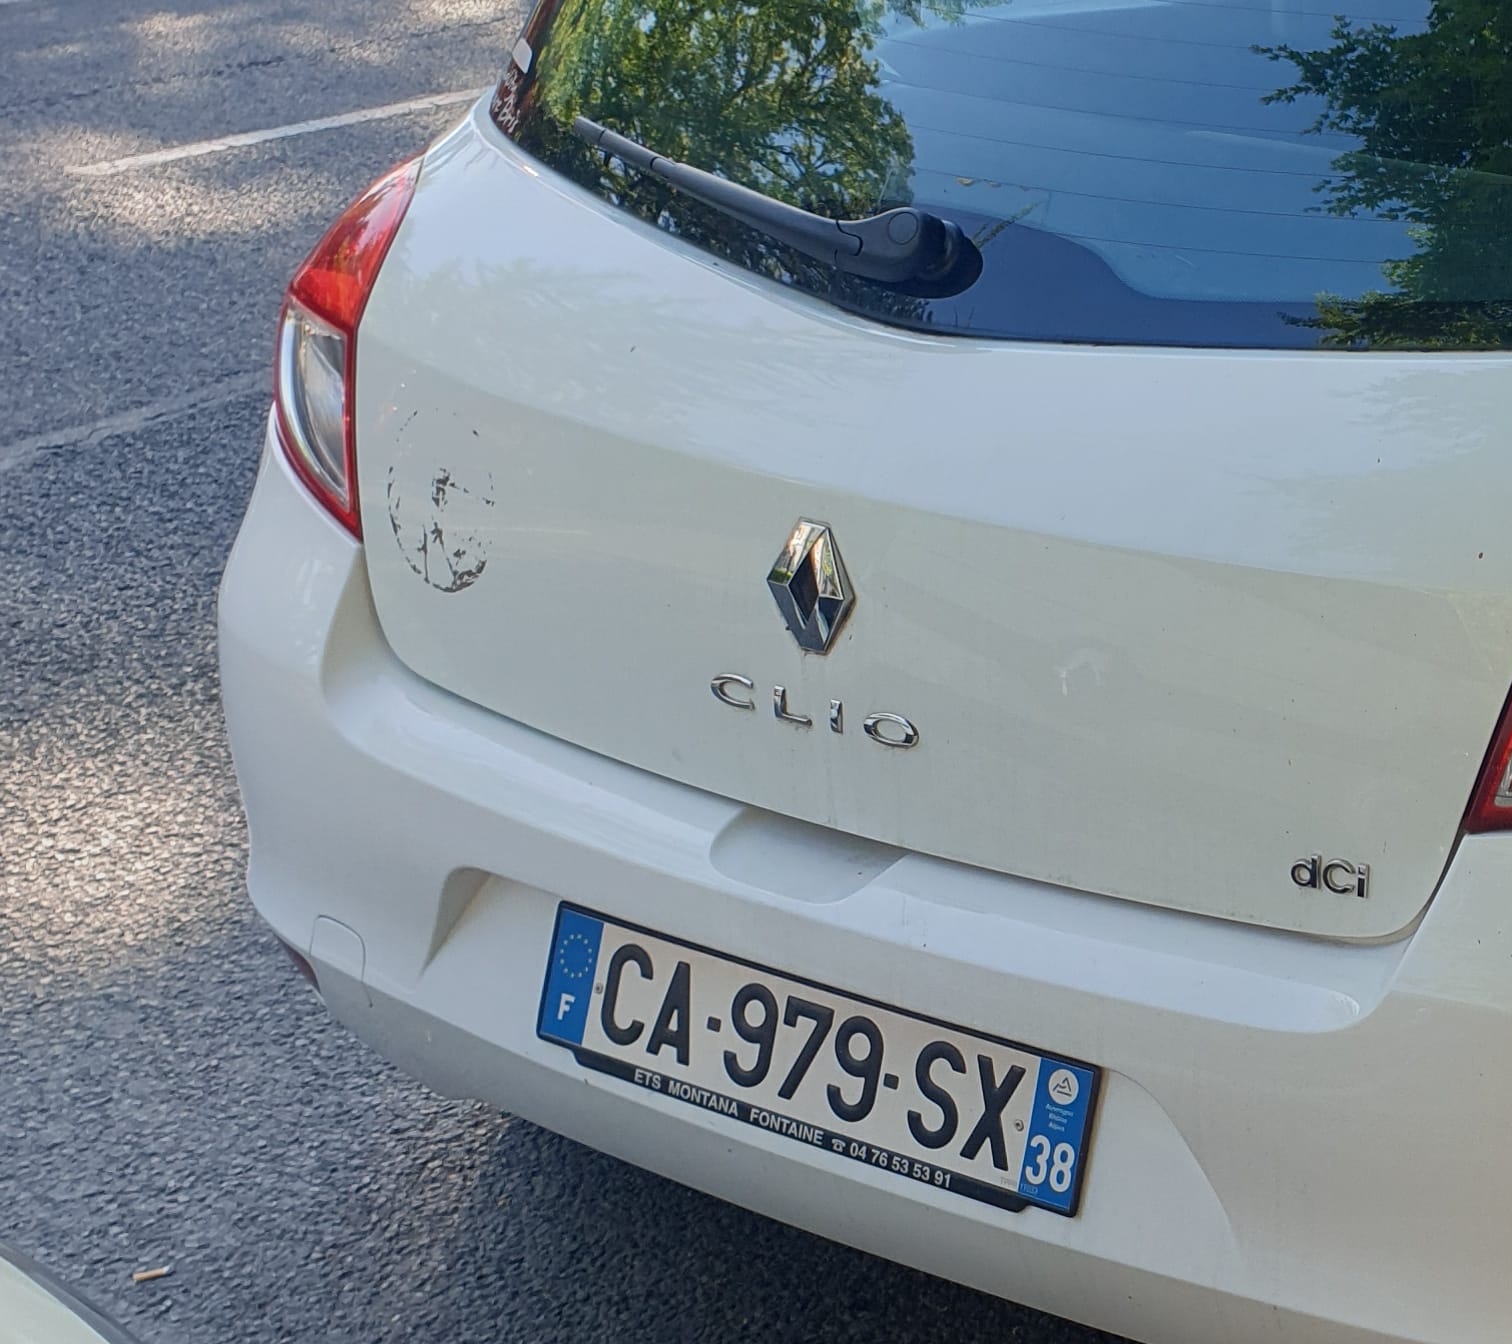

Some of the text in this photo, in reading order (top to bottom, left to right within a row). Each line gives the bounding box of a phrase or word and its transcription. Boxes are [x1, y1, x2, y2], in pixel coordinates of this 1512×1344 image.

[710, 672, 920, 748] CLIO
[1290, 854, 1369, 899] dCi
[557, 993, 576, 1021] F
[601, 943, 1027, 1172] CA-979-SX
[634, 1068, 951, 1189] ETS MONTANA FONTAINE 04 76 53 53 91
[1025, 1134, 1075, 1193] 38
